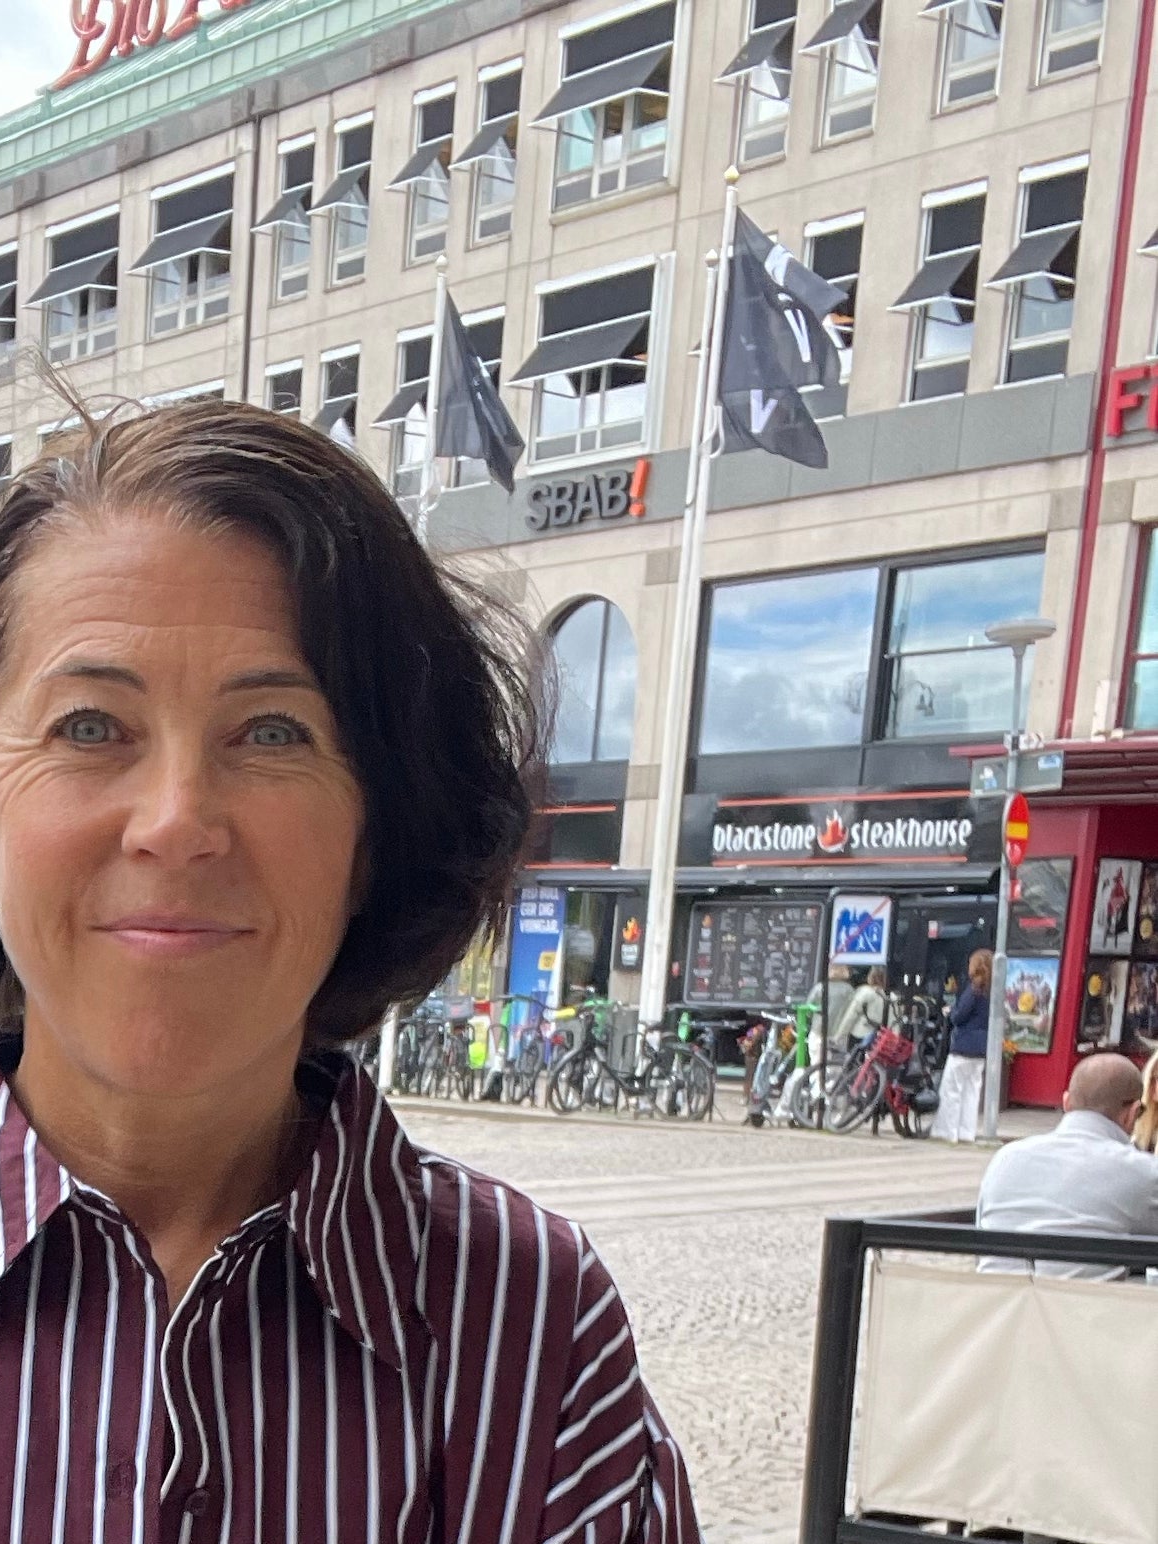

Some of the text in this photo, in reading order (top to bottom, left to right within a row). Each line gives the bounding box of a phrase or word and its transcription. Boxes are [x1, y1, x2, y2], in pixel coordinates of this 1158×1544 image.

[524, 457, 651, 531] SBAB!
[713, 817, 972, 852] blackstone steakhouse
